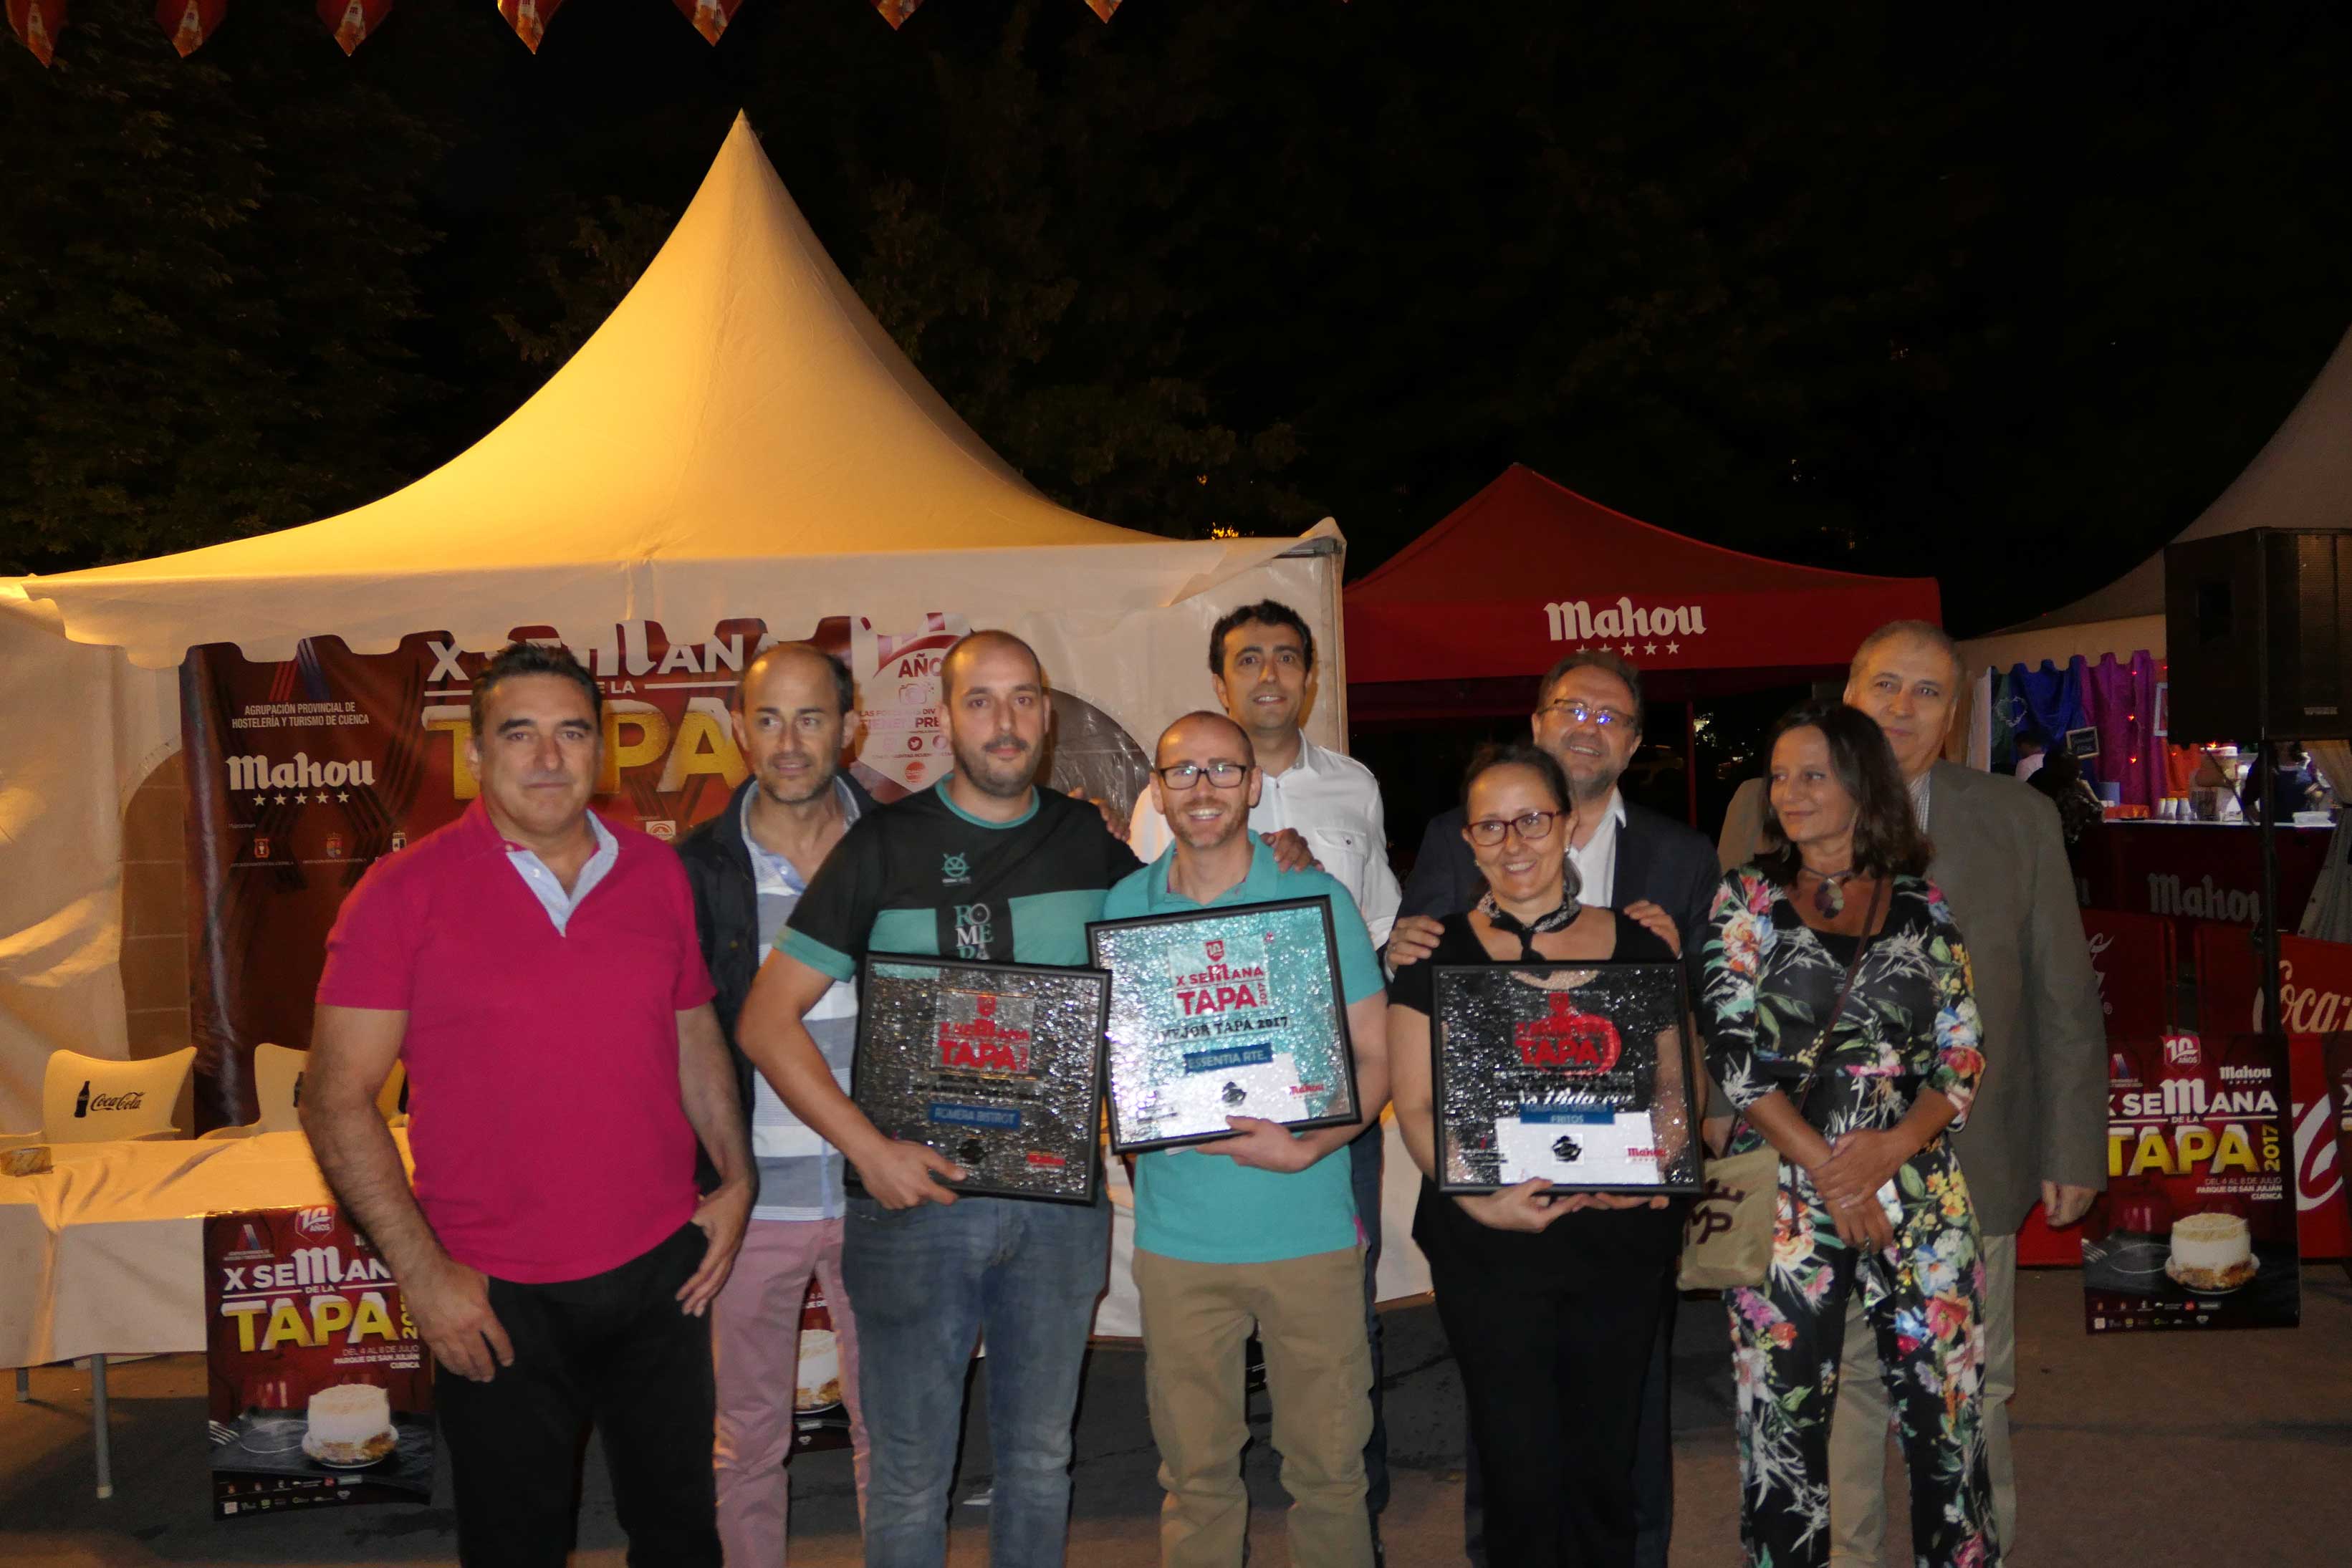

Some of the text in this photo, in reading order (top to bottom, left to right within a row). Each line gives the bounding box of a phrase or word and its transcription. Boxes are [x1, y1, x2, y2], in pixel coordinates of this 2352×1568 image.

[1543, 597, 1707, 641] Mahou
[426, 640, 470, 682] X
[898, 653, 942, 678] AÑO
[611, 680, 635, 693] LA
[232, 714, 369, 728] HOSTELERÍA Y TURISMO DE CUENCA
[245, 702, 355, 716] AGRUPACIÓN PROVINCIAL DE
[422, 696, 748, 800] TPA
[225, 752, 375, 790] Mahou
[1176, 976, 1186, 986] X
[1177, 984, 1259, 1016] TAPA
[1214, 1019, 1253, 1034] TAPA
[1257, 1016, 1288, 1029] 2017
[938, 1040, 1017, 1071] TAPA
[1189, 1053, 1241, 1069] ESSENTIA
[1515, 1039, 1600, 1065] TAPA
[2219, 1065, 2272, 1079] Mahou
[2122, 1078, 2278, 1117] SEMANA
[1550, 1115, 1584, 1123] FRITOS
[2108, 1124, 2261, 1177] TAPA
[2262, 1124, 2280, 1173] 2017
[223, 1246, 393, 1291] X SEMAN
[305, 1284, 335, 1294] DE LA
[221, 1292, 400, 1352] TAPA
